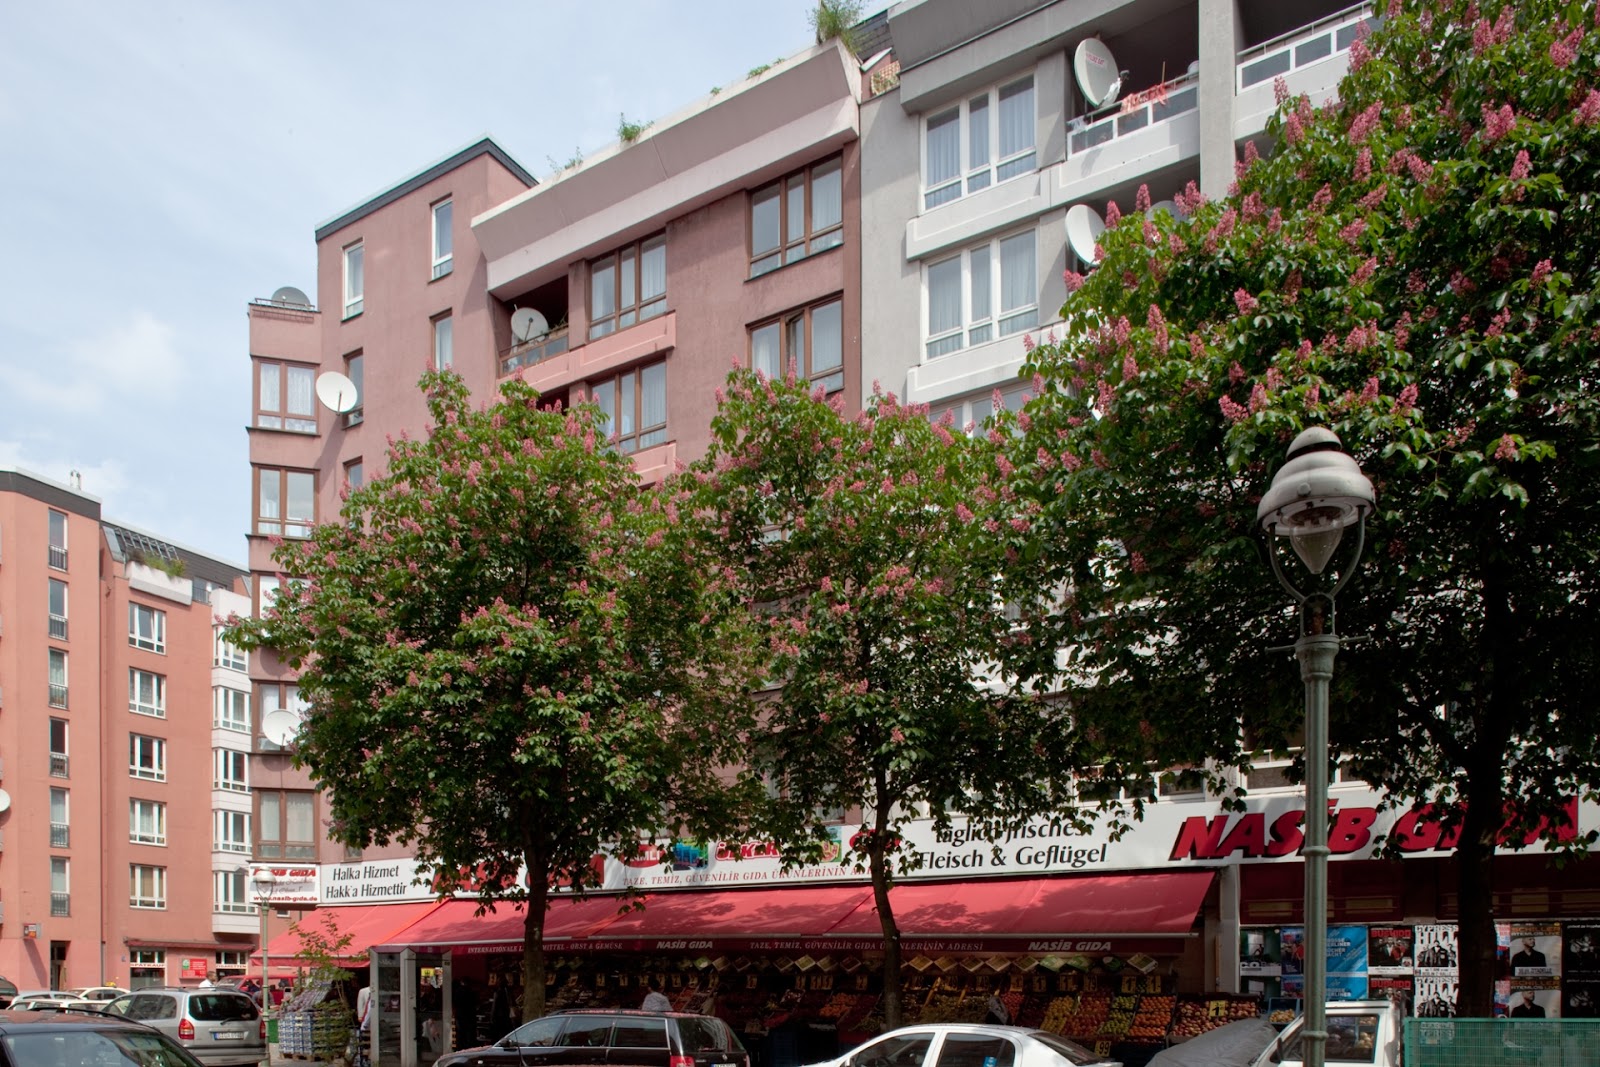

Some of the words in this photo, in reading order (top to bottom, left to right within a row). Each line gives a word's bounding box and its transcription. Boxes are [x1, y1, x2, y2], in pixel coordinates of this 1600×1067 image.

[1388, 795, 1578, 853] GIA
[936, 819, 1000, 847] täglic
[919, 849, 983, 869] Fleisch
[990, 846, 1007, 867] &
[1015, 843, 1107, 869] Geflügel
[289, 869, 317, 877] GIDA
[333, 866, 361, 881] Halka
[363, 865, 400, 879] Hizmet
[743, 871, 768, 880] GIDA
[361, 882, 407, 897] Hizmettir
[688, 941, 713, 949] GIDA
[854, 942, 876, 950] GIDA
[946, 941, 984, 950] ADRESİ
[1028, 939, 1072, 951] NASİB
[1075, 941, 1111, 951] GIDA
